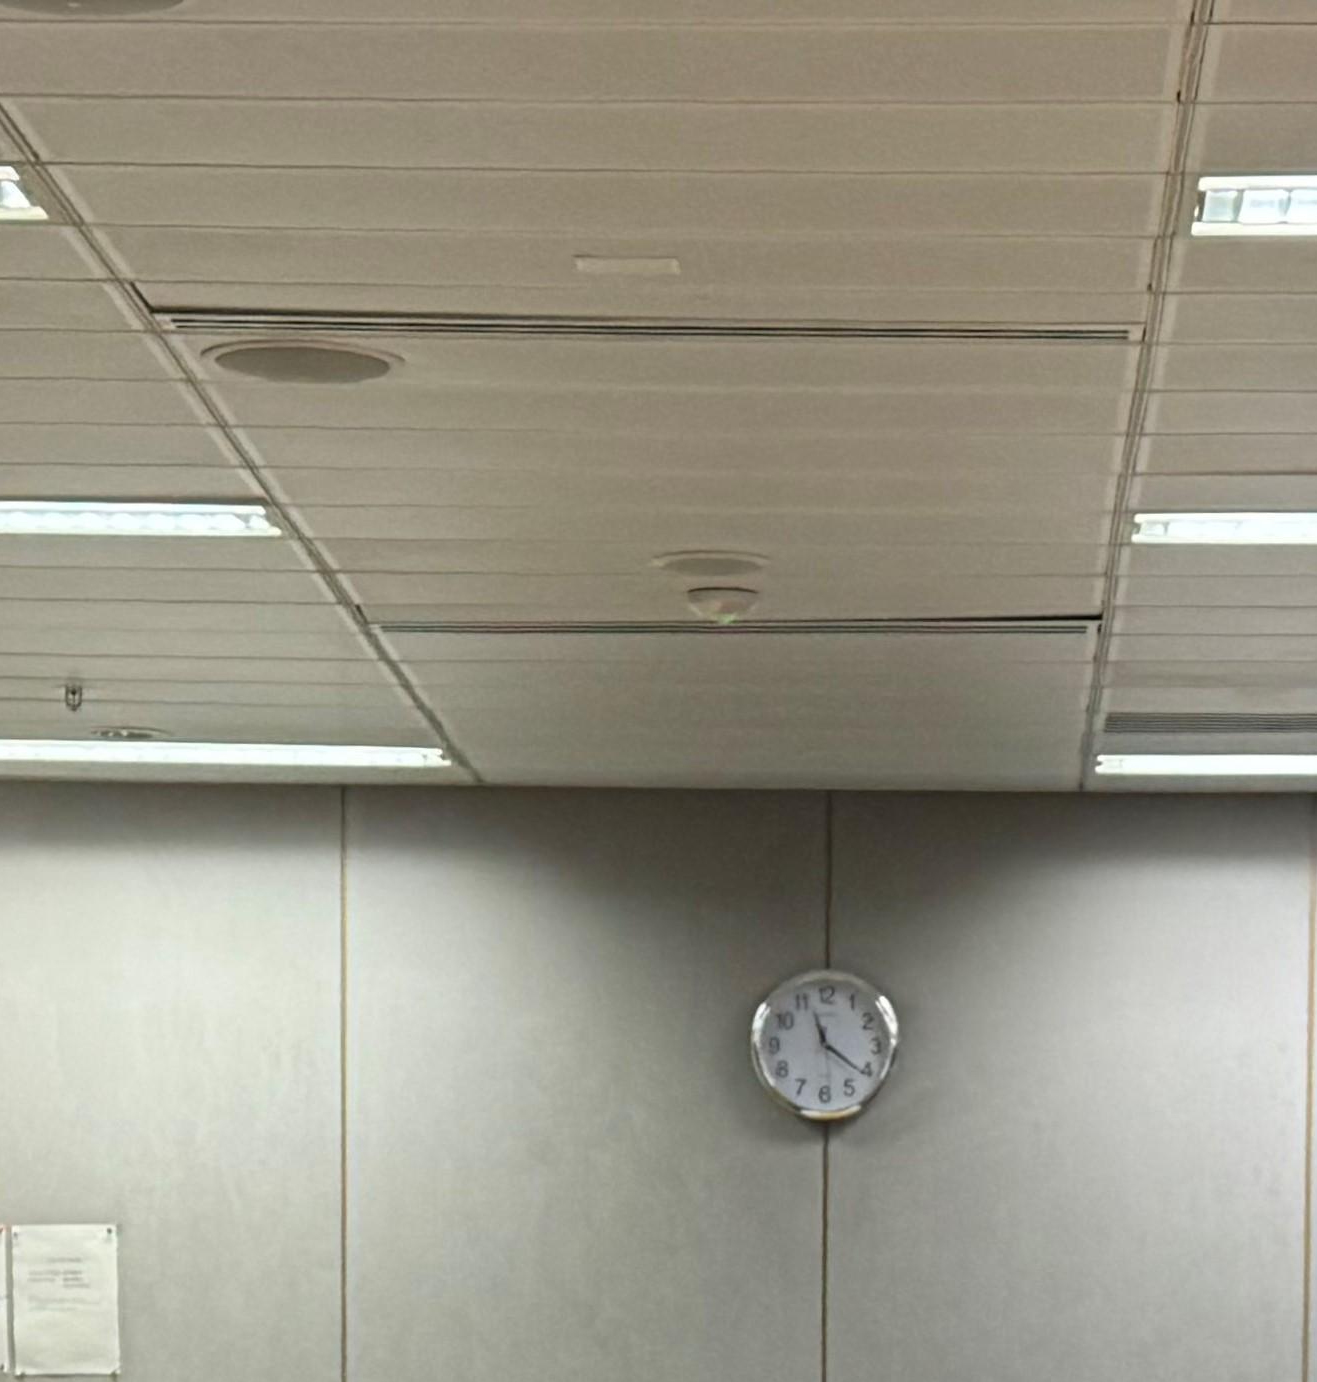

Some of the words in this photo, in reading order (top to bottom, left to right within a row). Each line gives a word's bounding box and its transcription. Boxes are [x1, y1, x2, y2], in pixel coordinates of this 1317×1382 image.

[796, 993, 808, 1010] 11
[819, 986, 835, 1004] 12
[849, 994, 855, 1010] 1
[778, 1012, 794, 1030] 10
[862, 1013, 874, 1030] 2
[769, 1037, 780, 1054] 9
[871, 1038, 881, 1054] 3
[776, 1061, 788, 1078] 8
[862, 1062, 873, 1077] 4
[795, 1079, 807, 1096] 7
[818, 1086, 831, 1103] 6
[844, 1079, 856, 1097] 5
